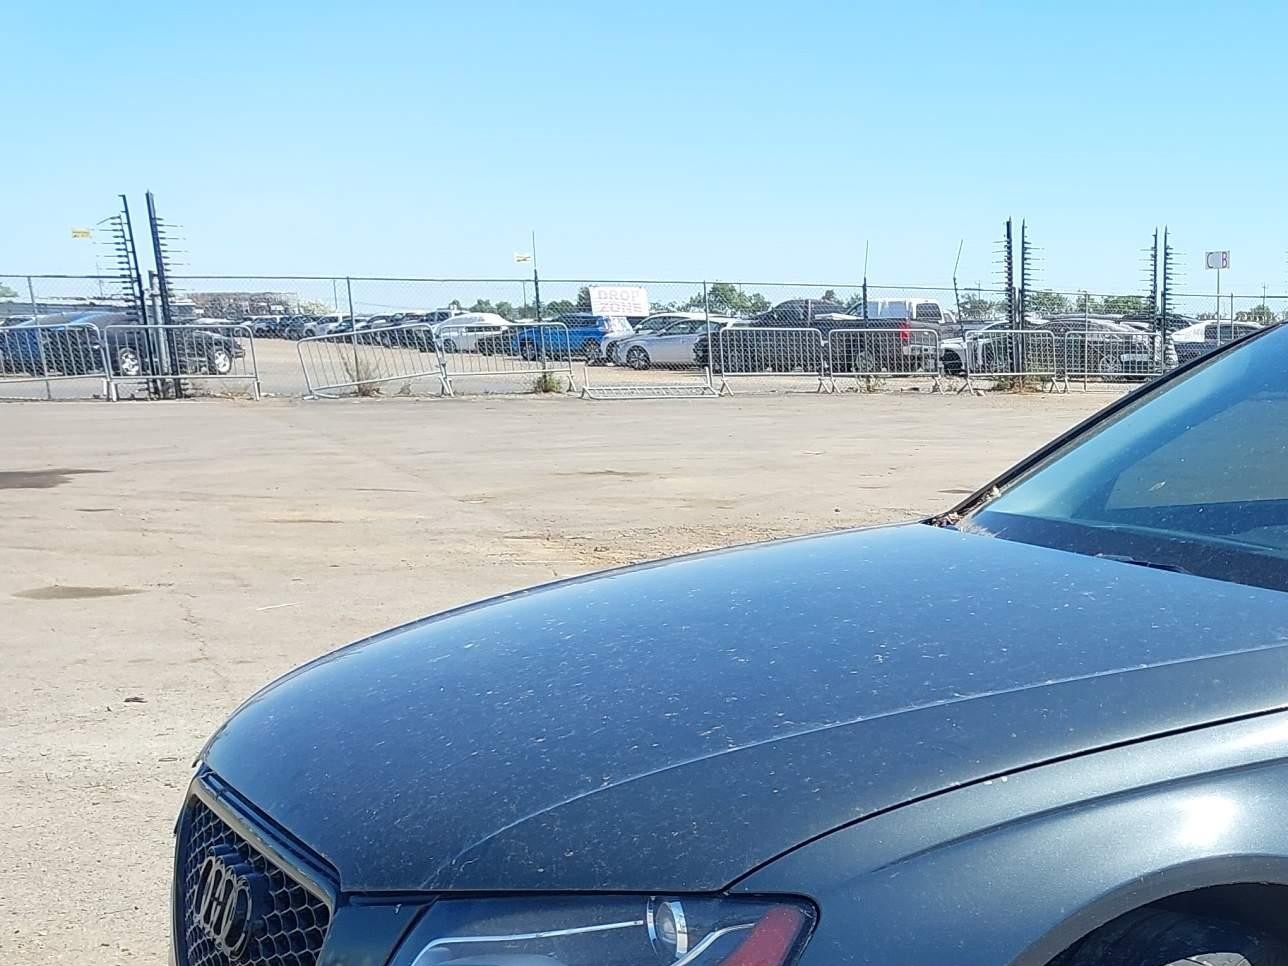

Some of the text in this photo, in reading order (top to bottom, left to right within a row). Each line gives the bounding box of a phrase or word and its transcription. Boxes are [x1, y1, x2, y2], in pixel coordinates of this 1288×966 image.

[1206, 251, 1228, 269] C B
[598, 289, 640, 301] DROP
[600, 302, 642, 313] ZONE
